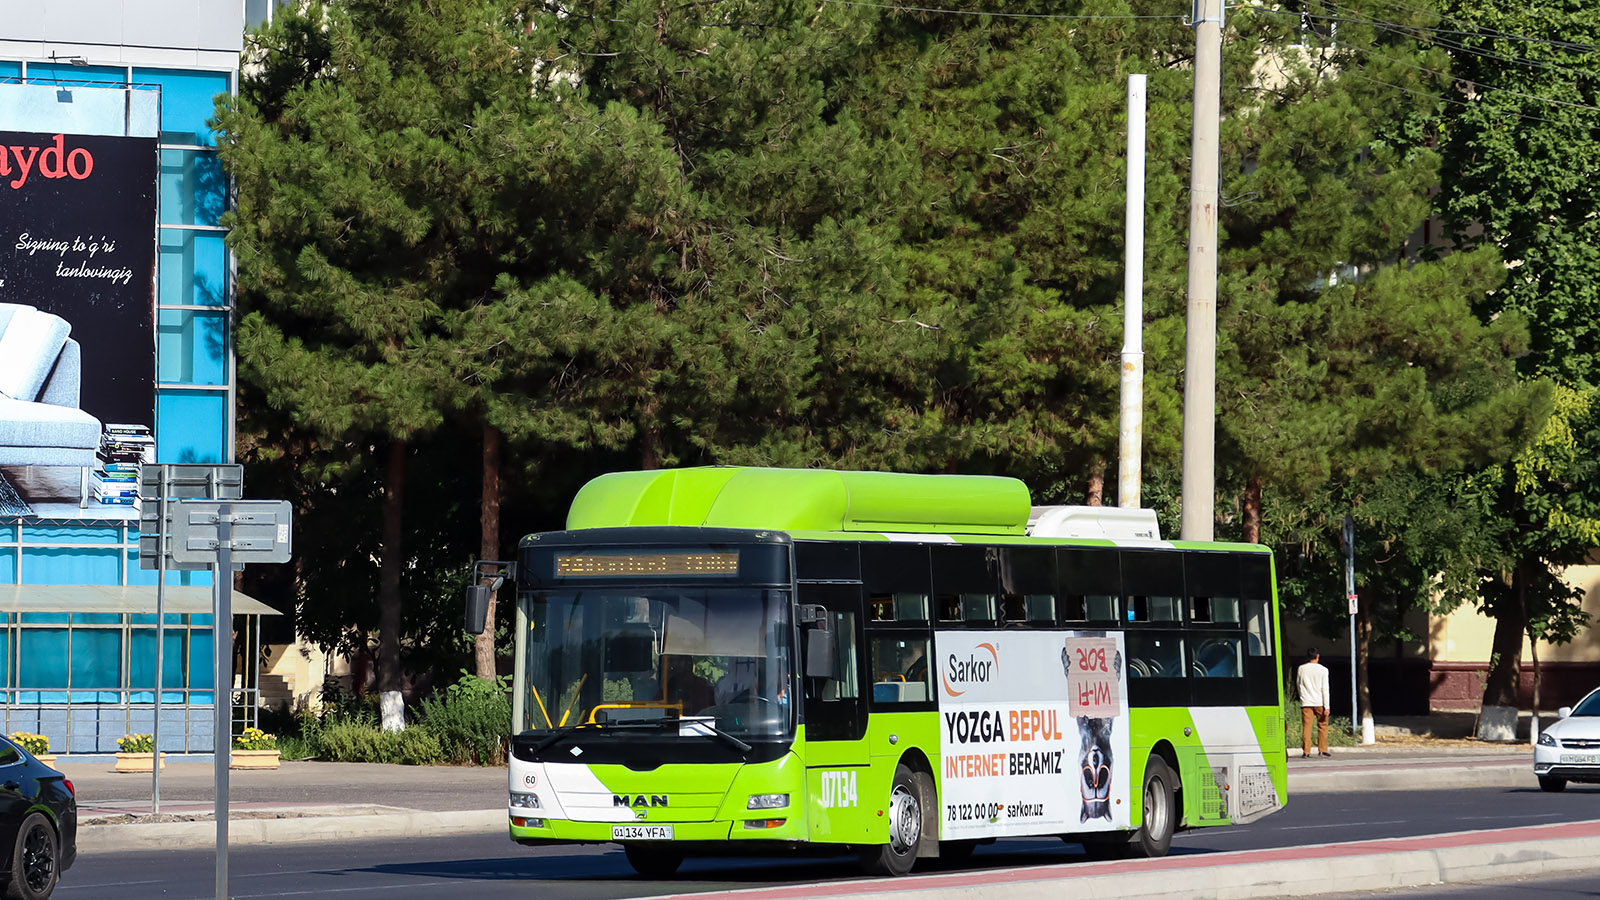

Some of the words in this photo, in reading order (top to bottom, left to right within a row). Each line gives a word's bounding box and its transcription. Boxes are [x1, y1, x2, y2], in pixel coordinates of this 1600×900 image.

[15, 232, 69, 257] Sizning
[56, 260, 133, 285] tanlovingiz
[949, 653, 992, 682] Sarkor
[1076, 648, 1108, 672] BOR
[1078, 680, 1111, 706] WI-FI
[945, 711, 1005, 744] YOZGA
[1009, 709, 1062, 742] BEPUL
[945, 753, 1006, 779] INTERNET
[525, 775, 536, 784] 60
[821, 770, 858, 808] 07134
[613, 795, 668, 807] MAN
[947, 805, 957, 821] 78
[959, 804, 973, 820] 122
[974, 803, 987, 819] 00
[1007, 801, 1043, 818] sarkor.uz
[614, 829, 624, 837] 01
[625, 827, 643, 838] 134
[646, 827, 666, 838] YFA
